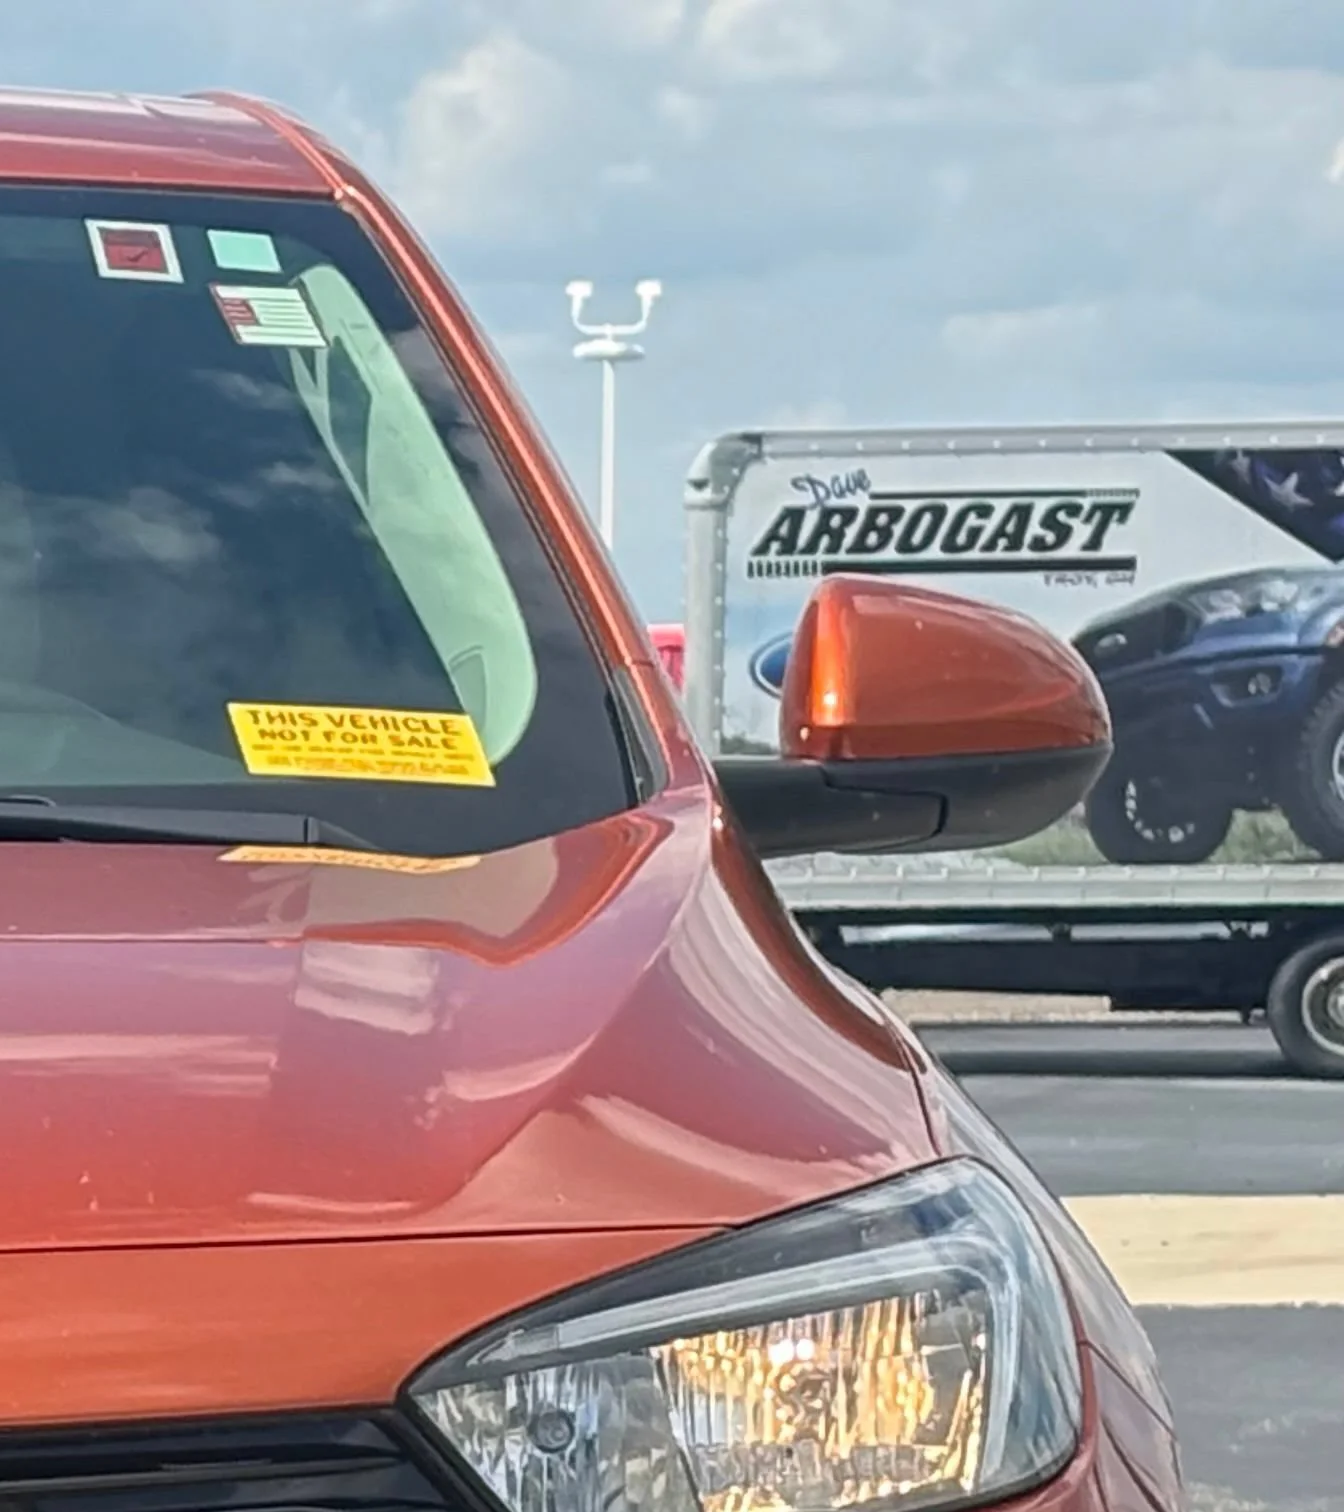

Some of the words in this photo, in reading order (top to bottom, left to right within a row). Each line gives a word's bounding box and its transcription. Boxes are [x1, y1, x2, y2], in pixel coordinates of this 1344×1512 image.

[790, 468, 871, 510] Dave
[750, 501, 1135, 557] ARBOGAST
[247, 709, 319, 727] THIS
[324, 713, 463, 736] VEHICLE
[258, 728, 311, 742] NOT
[322, 730, 378, 744] FOR
[387, 734, 458, 750] SALE
